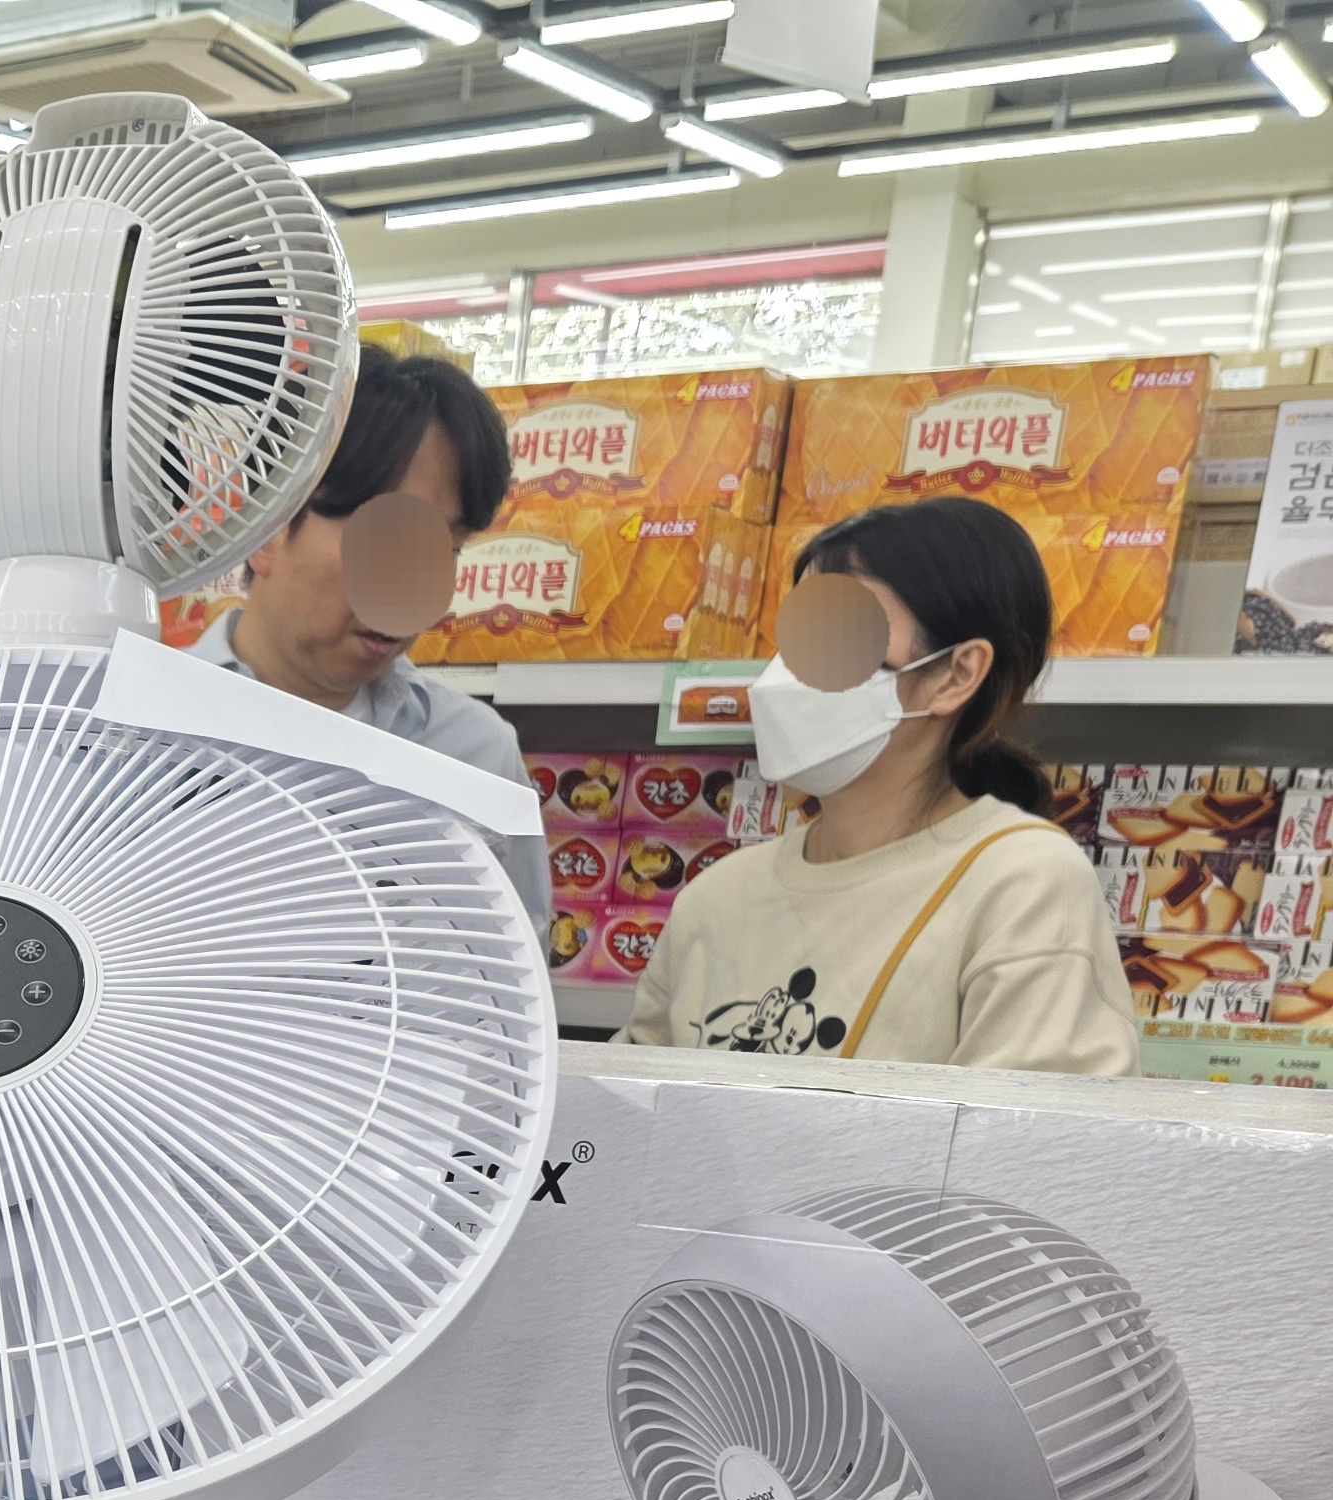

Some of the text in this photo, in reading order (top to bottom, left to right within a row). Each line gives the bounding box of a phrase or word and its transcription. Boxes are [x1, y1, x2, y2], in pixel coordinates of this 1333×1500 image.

[1132, 369, 1196, 388] PACKS
[694, 380, 753, 399] PACKS
[511, 423, 629, 466] 버터와플
[917, 412, 1053, 459] 버터와플
[640, 519, 697, 539] PACKS
[1103, 529, 1167, 547] PACKS
[642, 780, 691, 805] 칸쵸
